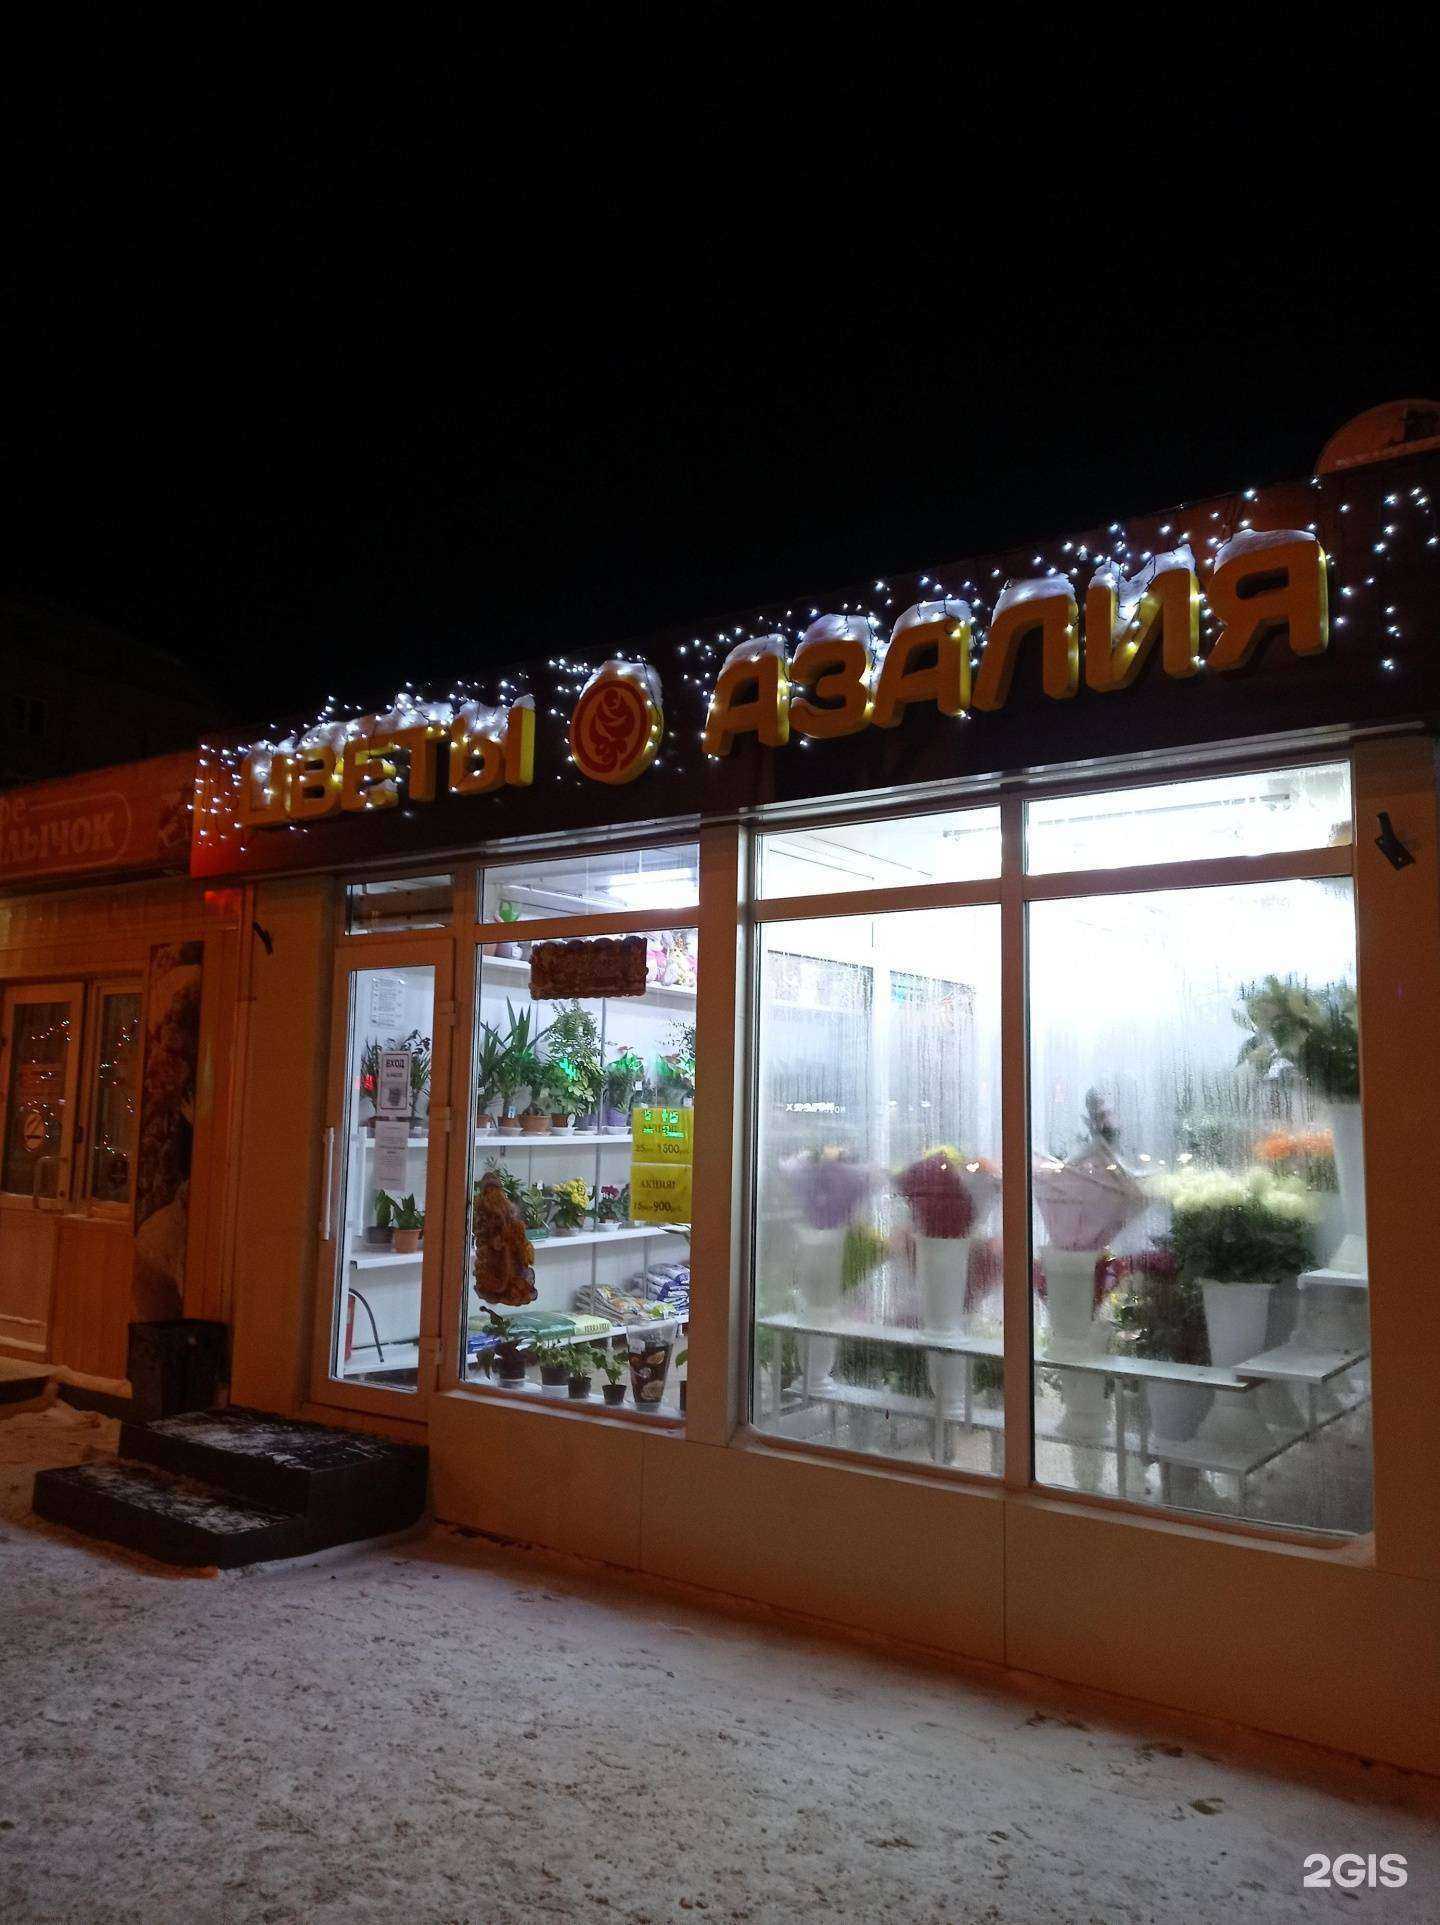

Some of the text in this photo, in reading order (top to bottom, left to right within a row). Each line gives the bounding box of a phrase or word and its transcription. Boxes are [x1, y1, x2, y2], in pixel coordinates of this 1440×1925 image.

[702, 535, 1329, 756] АЗАЛИЯ
[237, 703, 536, 826] ЦВЕТЫ
[0, 810, 114, 864] ЛЫЧОК
